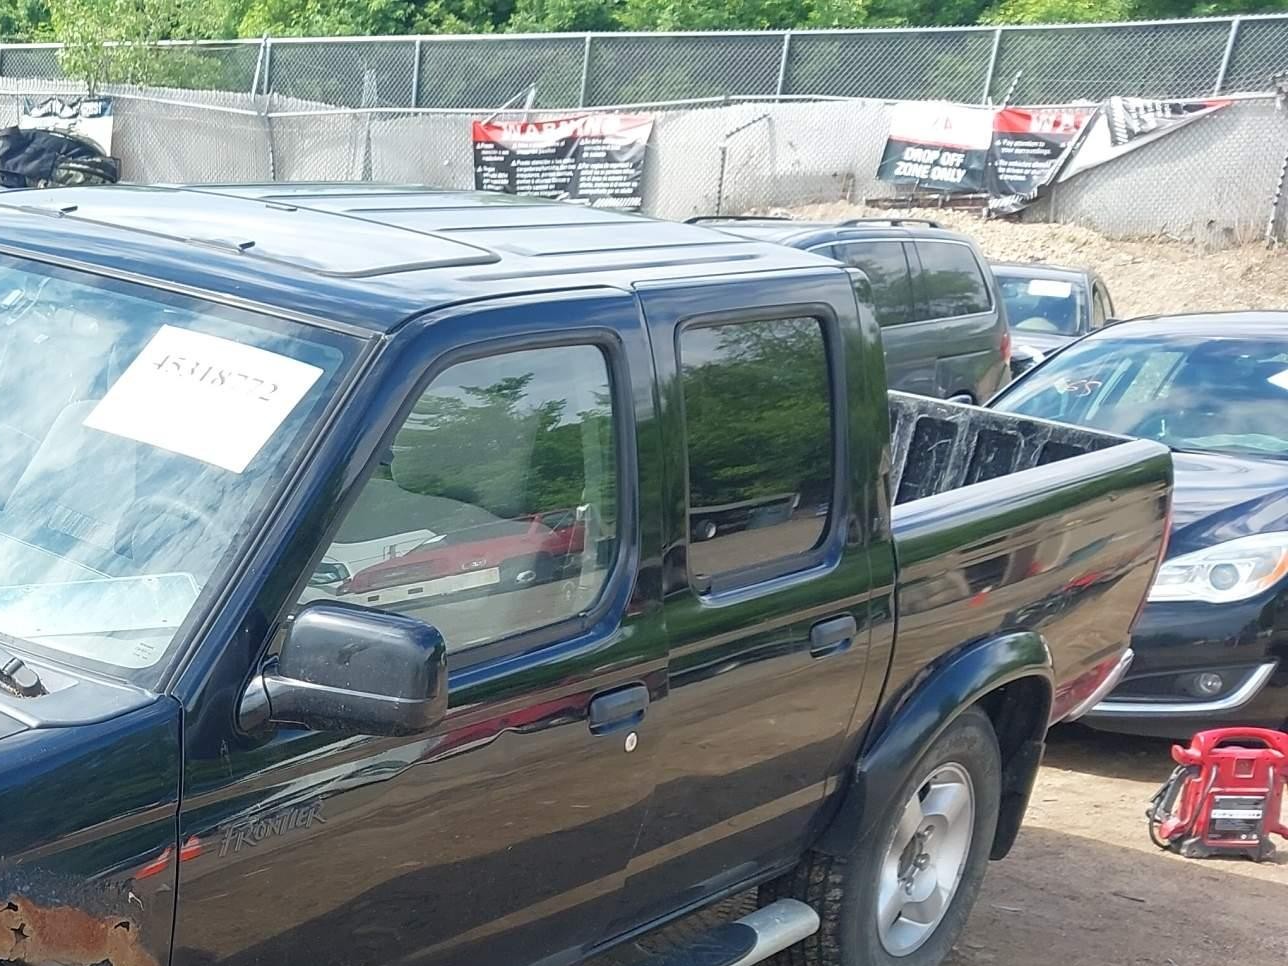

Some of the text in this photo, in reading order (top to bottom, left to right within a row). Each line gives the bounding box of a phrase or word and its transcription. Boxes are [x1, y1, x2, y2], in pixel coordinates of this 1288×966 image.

[894, 162, 966, 183] ZONE ONLY
[903, 147, 965, 167] DROP OFF
[153, 354, 279, 402] 45318772
[218, 801, 328, 857] FRONTIER
